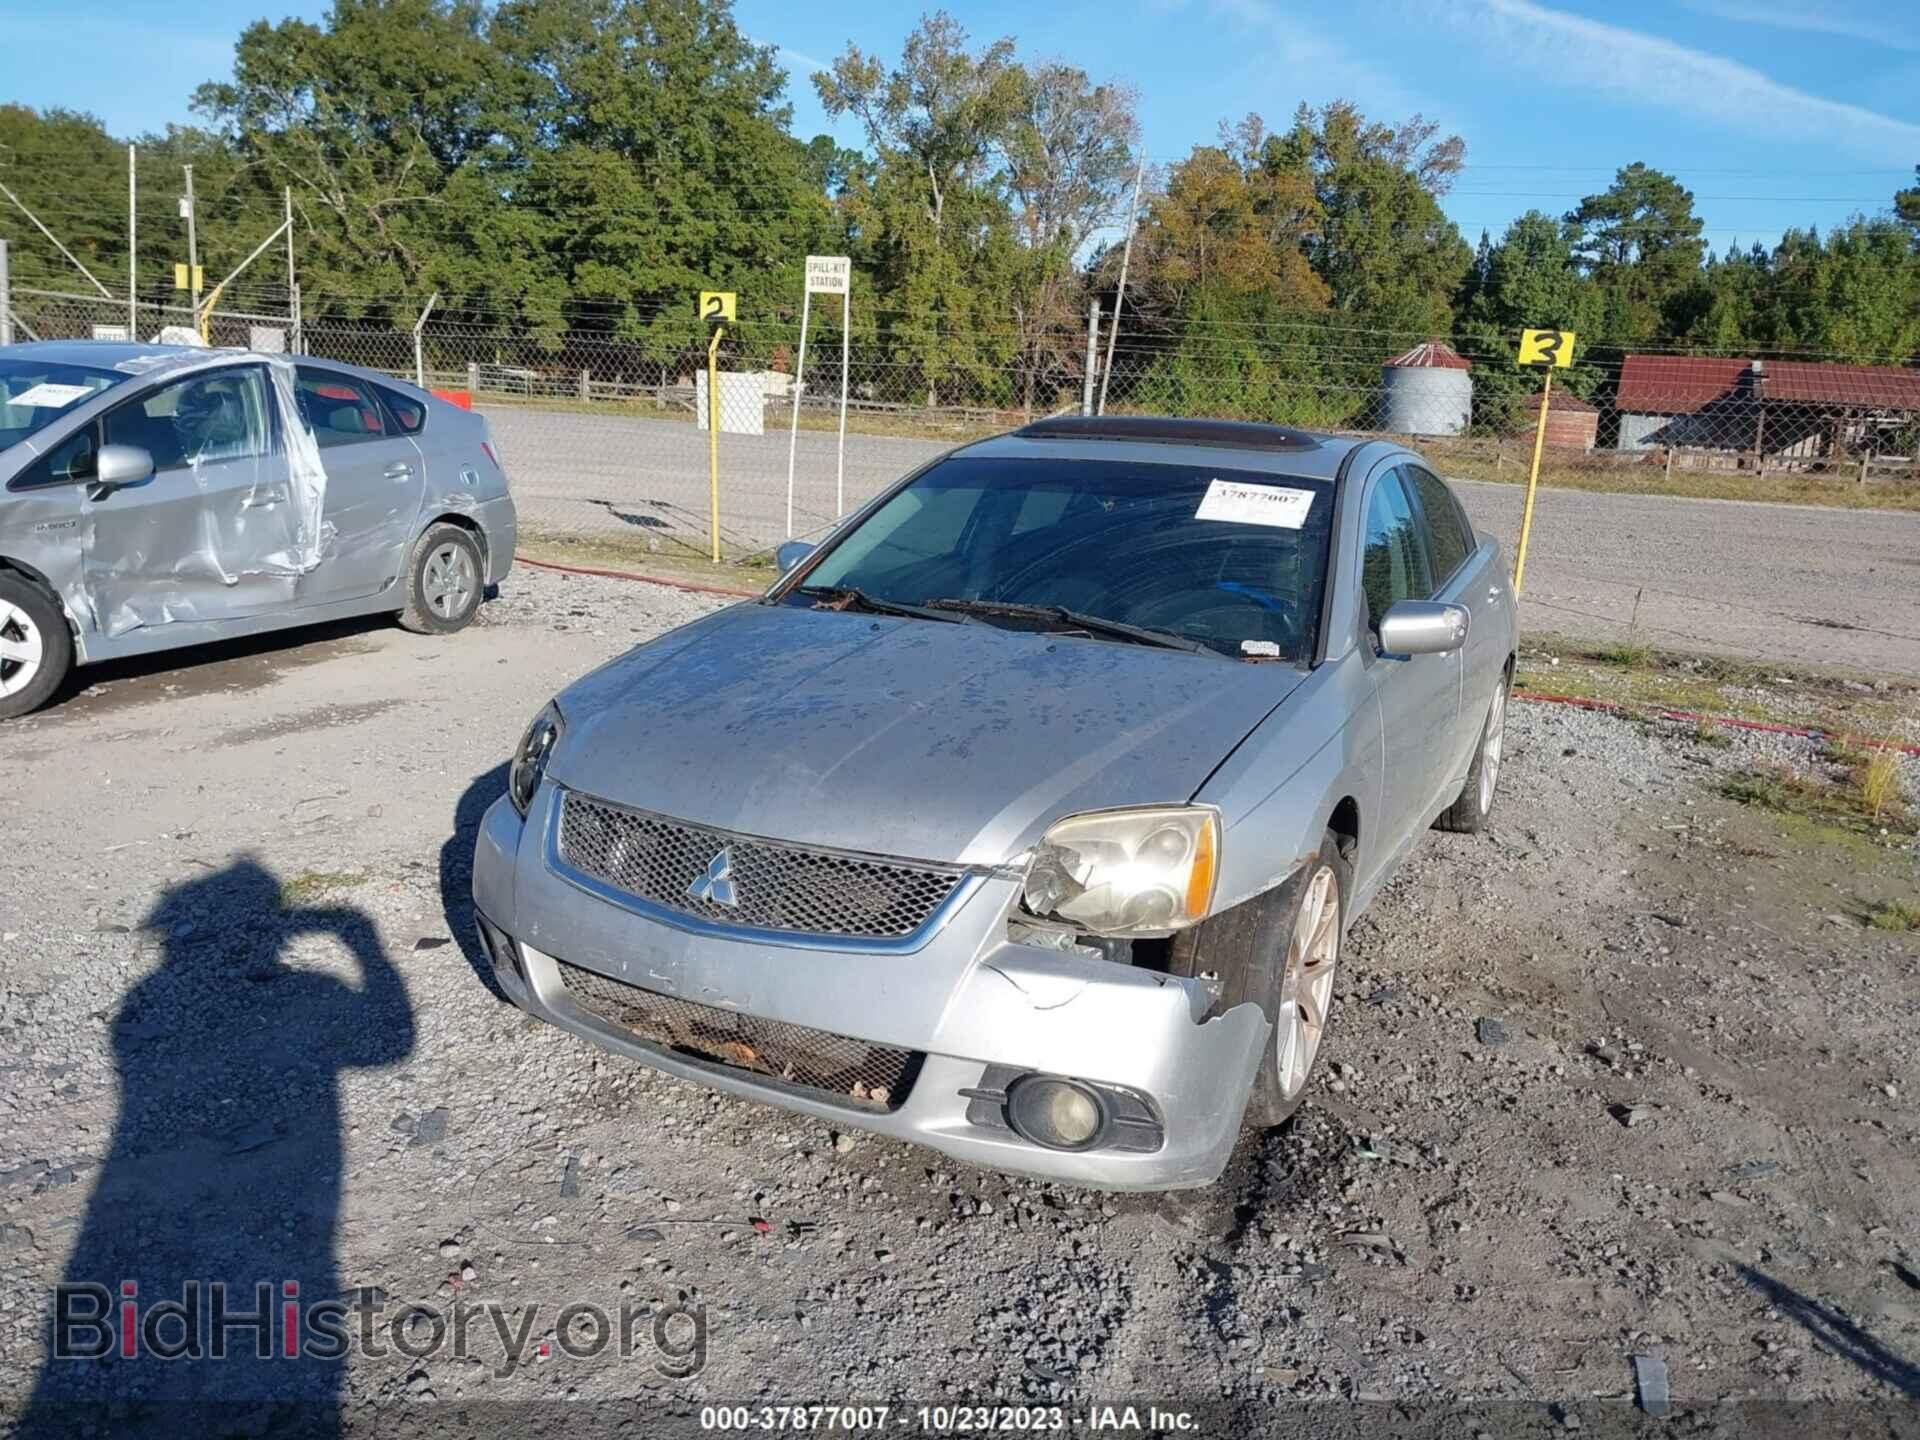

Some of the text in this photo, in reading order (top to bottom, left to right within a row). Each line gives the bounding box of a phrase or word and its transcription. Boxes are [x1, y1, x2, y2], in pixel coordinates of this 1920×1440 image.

[810, 275, 843, 288] STATION
[704, 296, 729, 320] 2
[1531, 331, 1564, 365] 3
